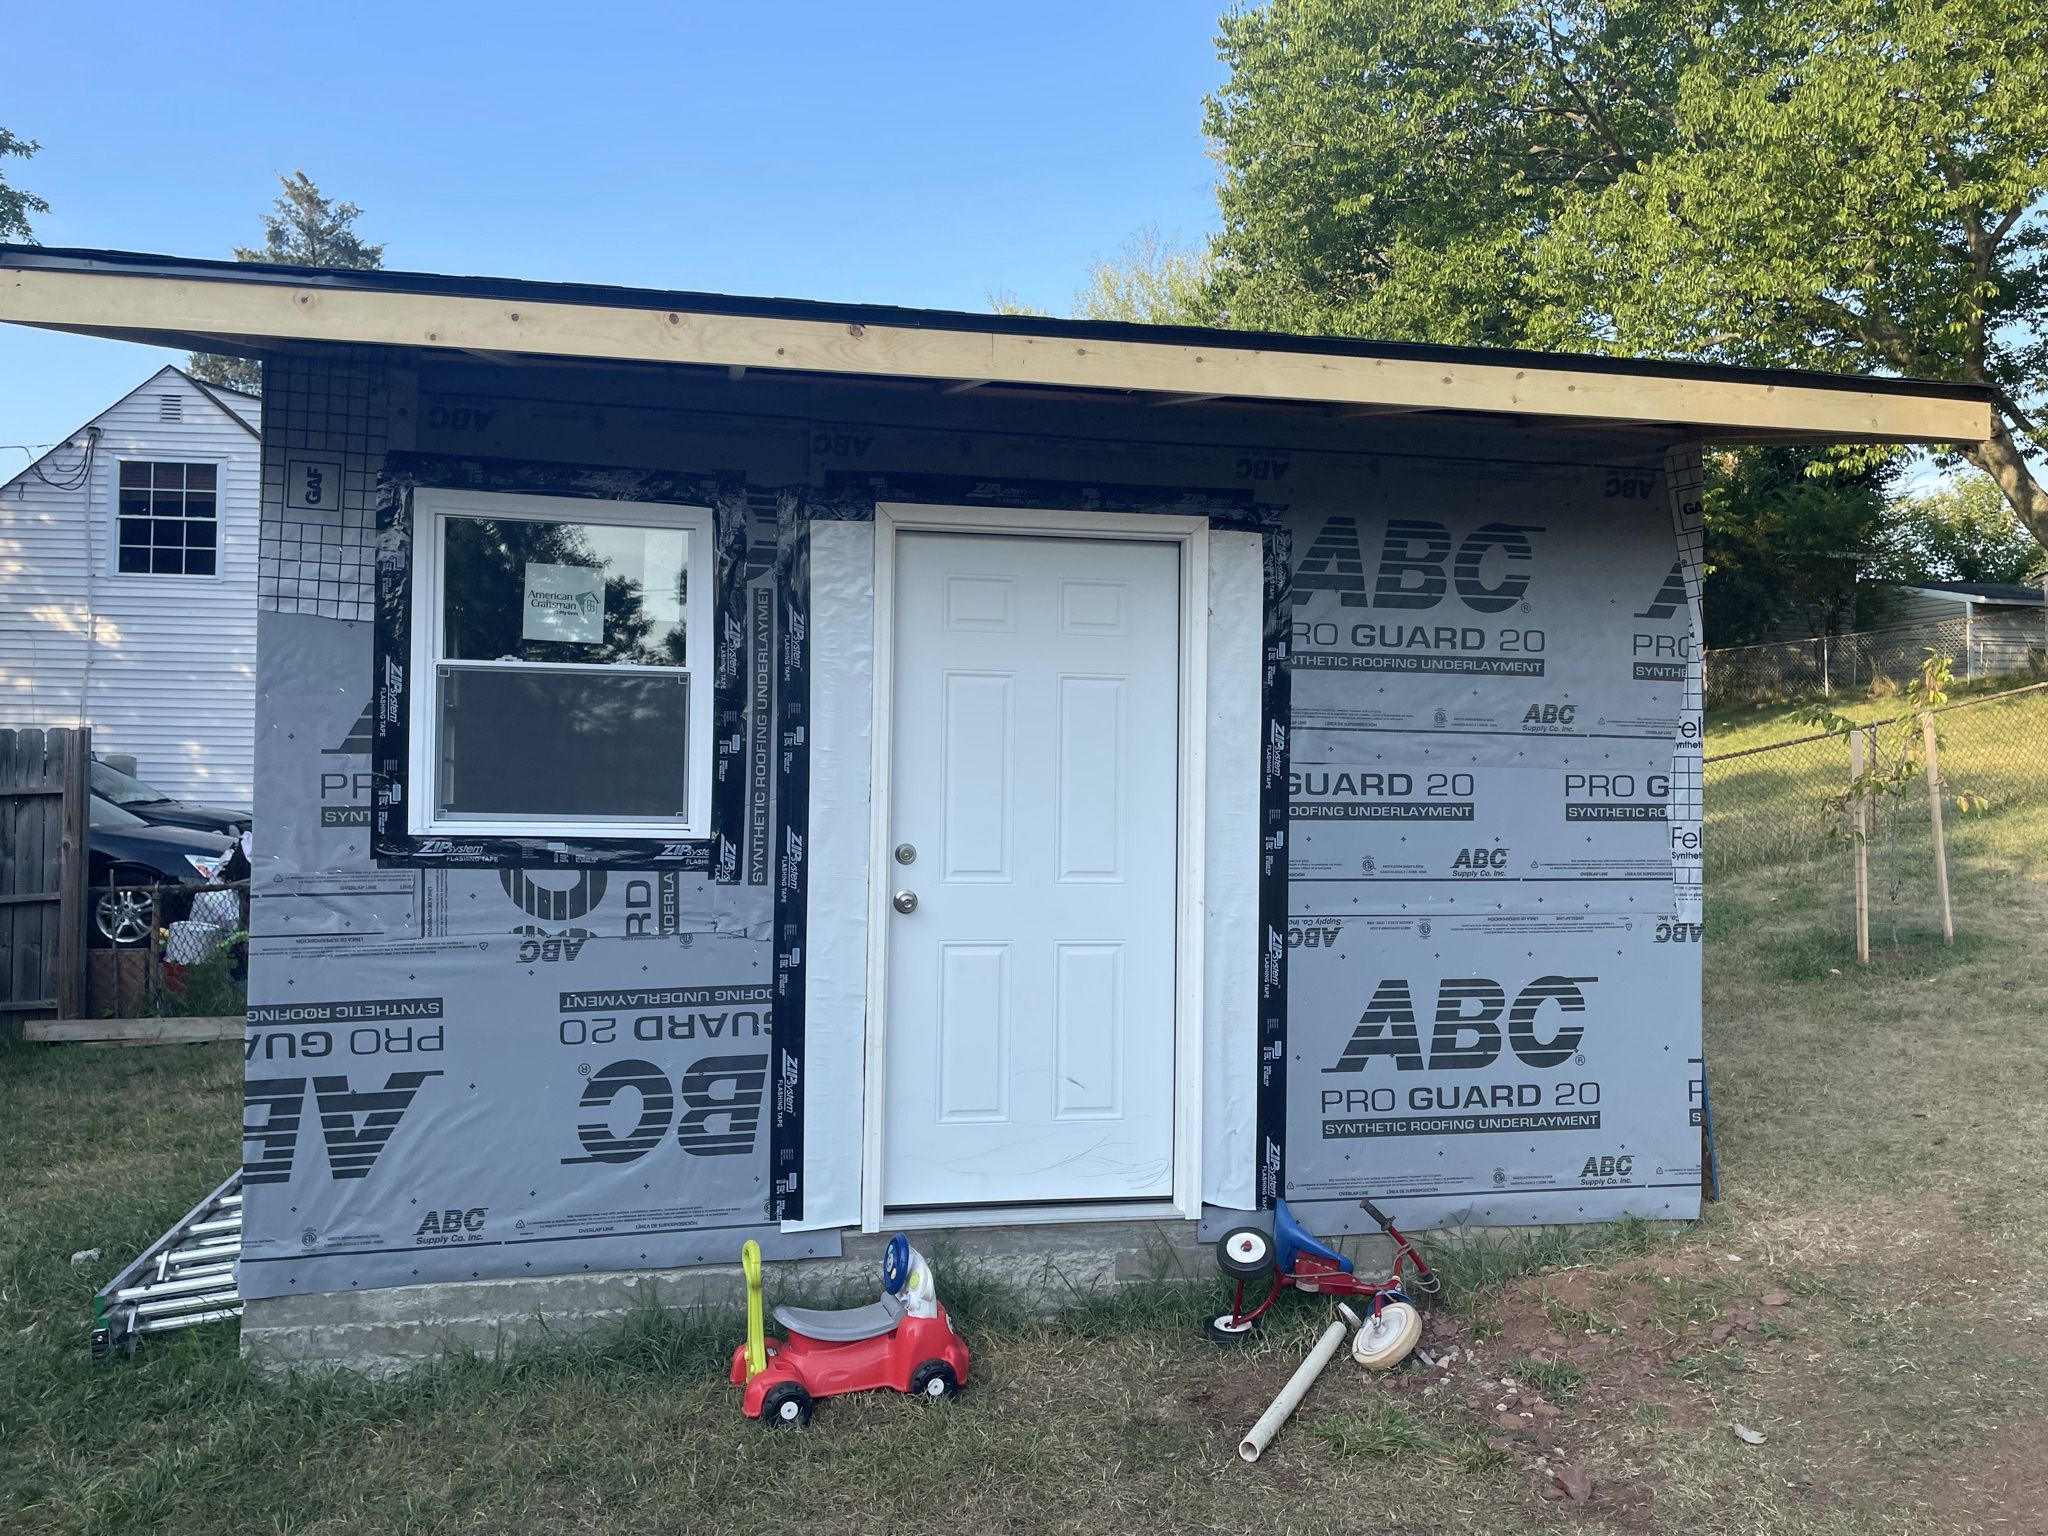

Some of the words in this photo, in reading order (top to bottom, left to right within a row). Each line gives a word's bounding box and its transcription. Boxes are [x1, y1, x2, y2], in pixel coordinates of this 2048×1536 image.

[1236, 459, 1289, 480] ABC
[305, 466, 322, 504] GAF
[1602, 478, 1656, 498] ABC
[1292, 516, 1546, 613] ABC
[528, 590, 573, 600] American
[531, 600, 577, 610] Craftsman
[1351, 624, 1486, 650] GUARD
[1500, 630, 1546, 652] 20
[1353, 657, 1417, 669] ROOFING
[1421, 659, 1543, 672] UNDERLAYMENT
[1520, 704, 1578, 724] ABC
[1522, 724, 1548, 733] Supply
[755, 714, 767, 788] ROOFING
[1427, 774, 1474, 797] 20
[1565, 775, 1635, 798] PRO
[1289, 806, 1344, 817] OOFING
[1349, 806, 1472, 817] UNDERLAYMENT
[1568, 807, 1645, 818] SYNTHETIC
[752, 791, 765, 883] SYNTHETIC
[1672, 827, 1702, 849] Fel
[1450, 848, 1510, 869] ABC
[1452, 870, 1479, 878] Supply
[1315, 918, 1341, 926] Supply
[1288, 927, 1344, 948] ABC
[1653, 923, 1703, 943] ABC
[516, 938, 590, 963] ABC
[336, 1002, 440, 1018] SYNTHETIC
[563, 991, 710, 1008] UNDERLAYMENT
[247, 1007, 330, 1022] ROOFING
[1320, 975, 1598, 1073] ABC
[350, 1025, 444, 1055] PRO
[560, 1018, 617, 1045] 20
[1321, 1088, 1395, 1114] PRO
[1409, 1084, 1542, 1111] GUARD
[1555, 1082, 1601, 1106] 20
[1325, 1121, 1407, 1136] SYNTHETIC
[1410, 1118, 1475, 1132] ROOFING
[1479, 1115, 1598, 1130] UNDERLAYMENT
[1578, 1155, 1635, 1178] ABC
[1580, 1178, 1605, 1187] Supply
[412, 1208, 489, 1235] ABC
[416, 1236, 449, 1245] Supply
[451, 1234, 465, 1242] Co.
